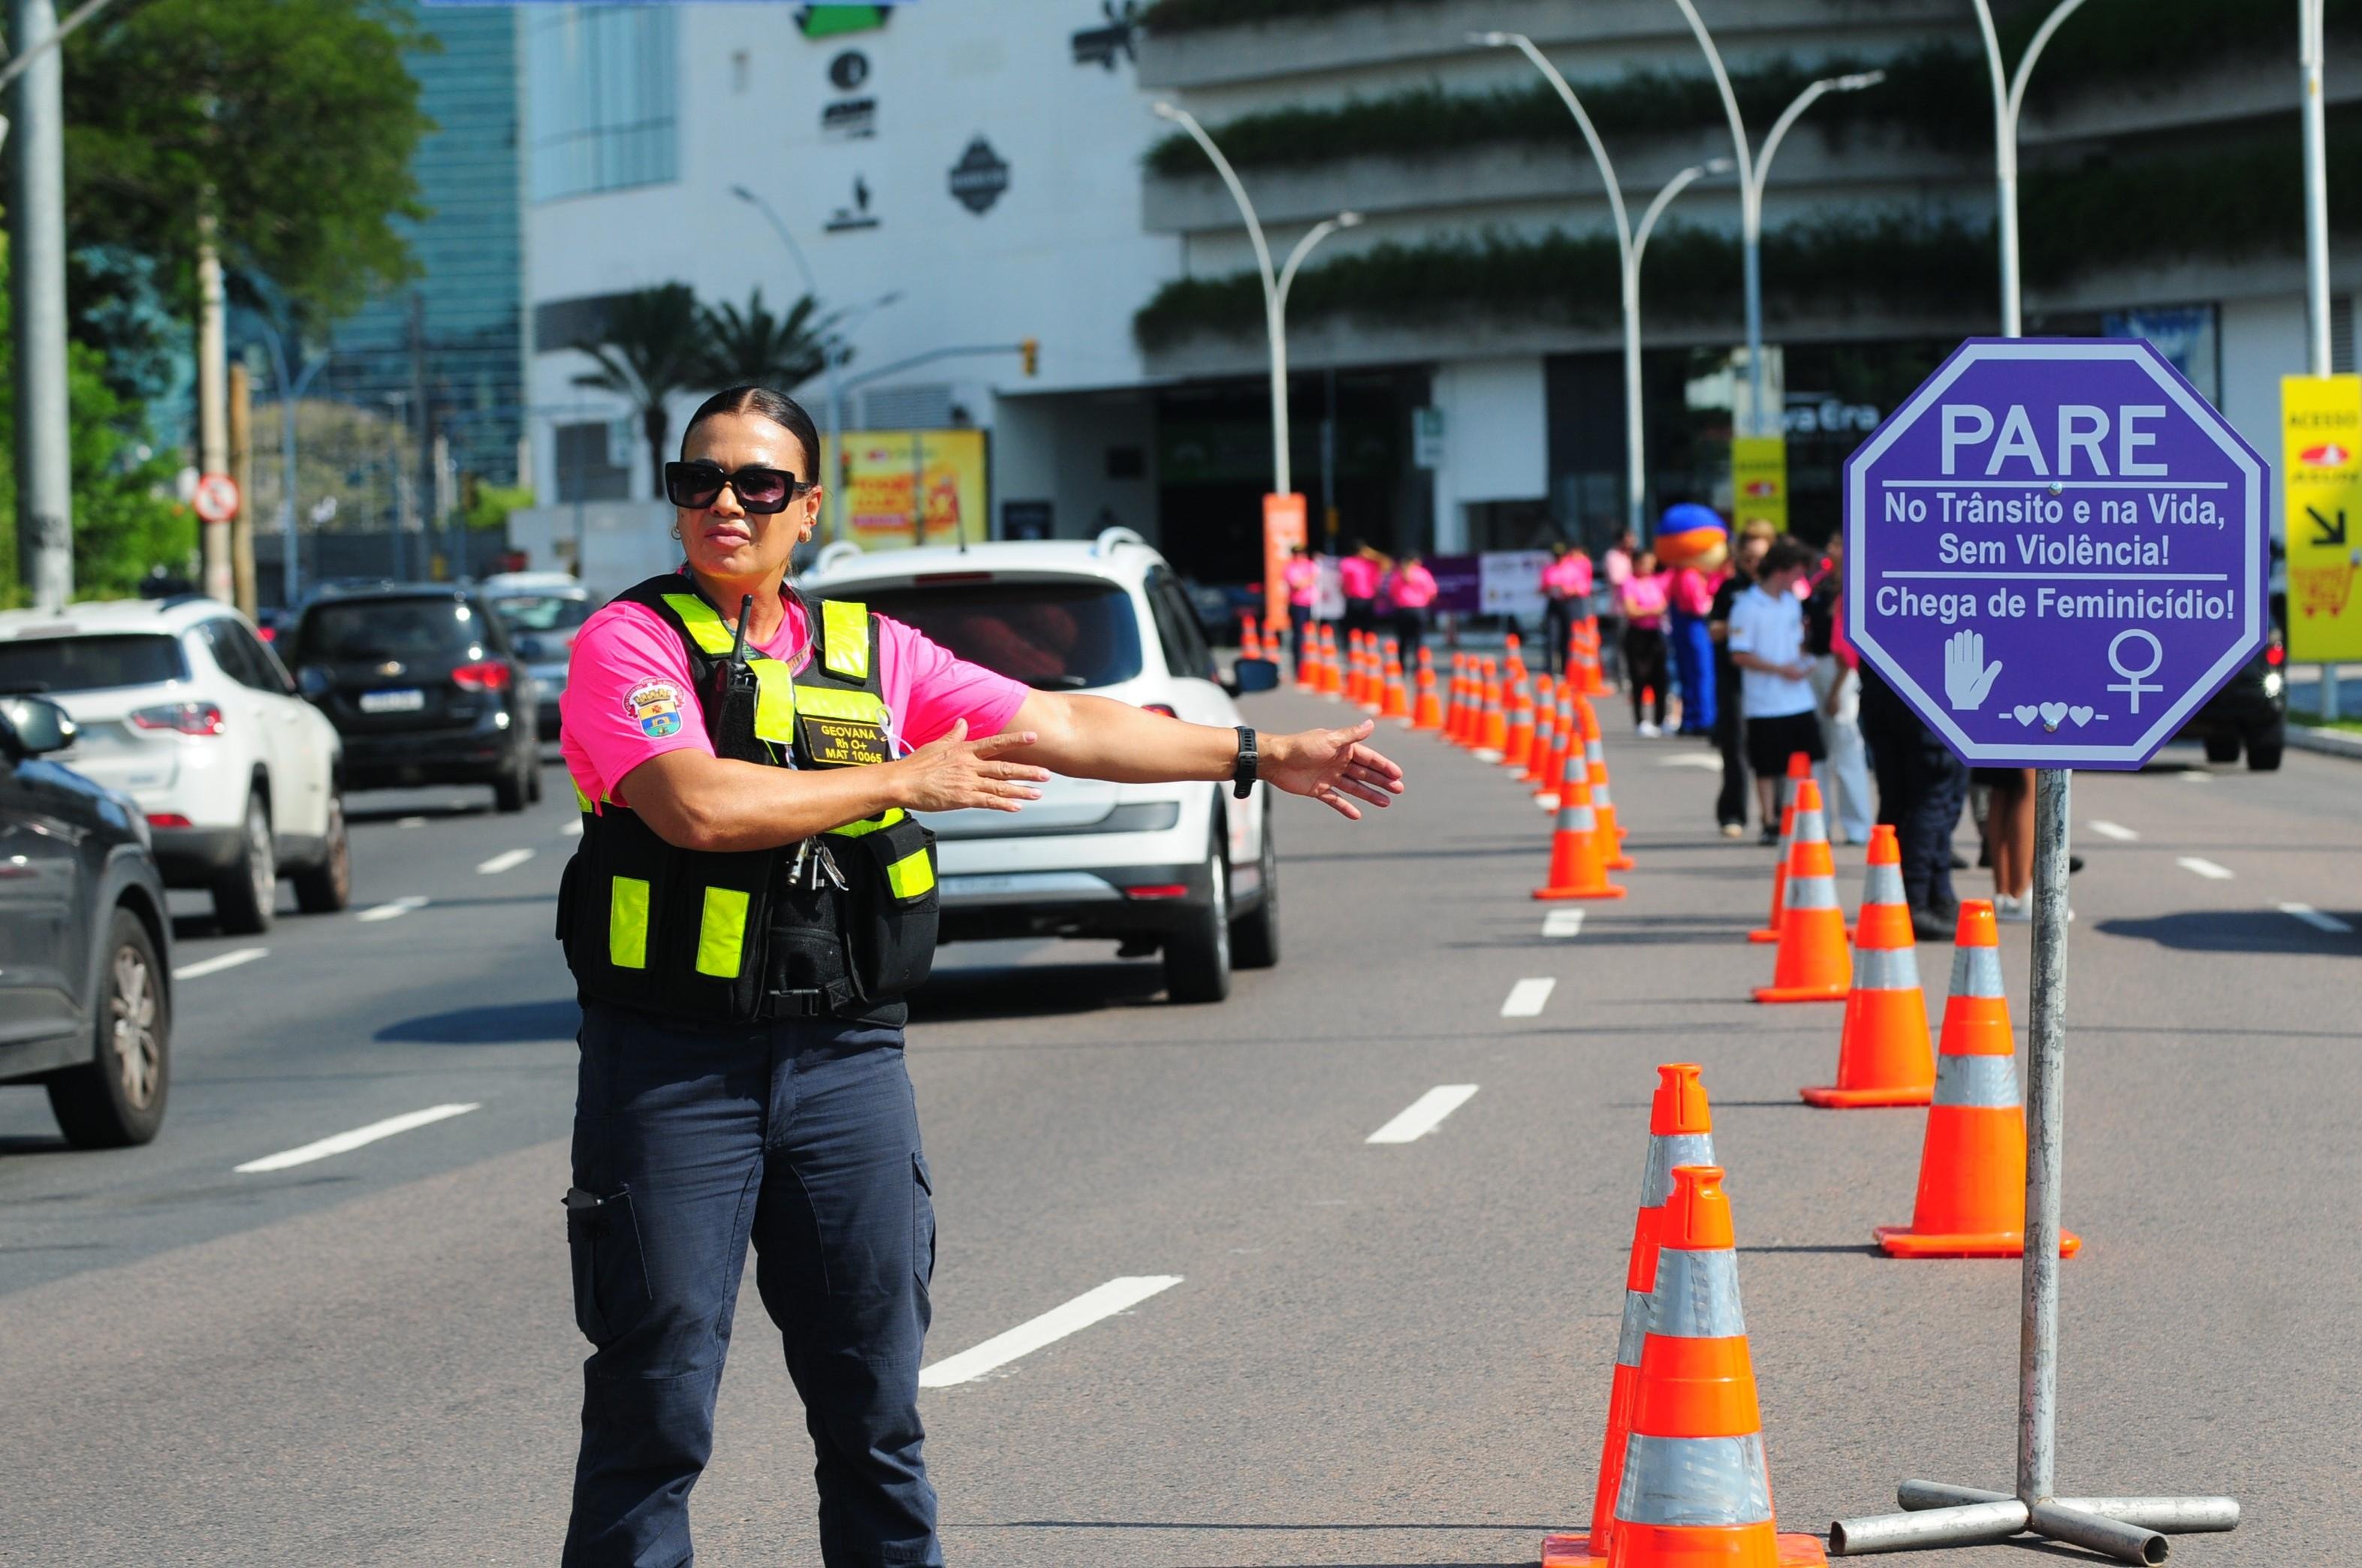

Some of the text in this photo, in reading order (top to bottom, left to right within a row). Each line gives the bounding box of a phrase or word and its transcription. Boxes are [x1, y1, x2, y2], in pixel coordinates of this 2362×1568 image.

[1941, 404, 2168, 476] PARE
[1886, 490, 2224, 529] No Trânsito e na Vida,
[1939, 533, 2168, 565] Sem Violência!
[1877, 586, 2234, 624] Chega de Feminicídio!
[821, 725, 876, 740] GEOVANA
[835, 738, 867, 749] Rh O+
[825, 748, 882, 763] MAT 10065
